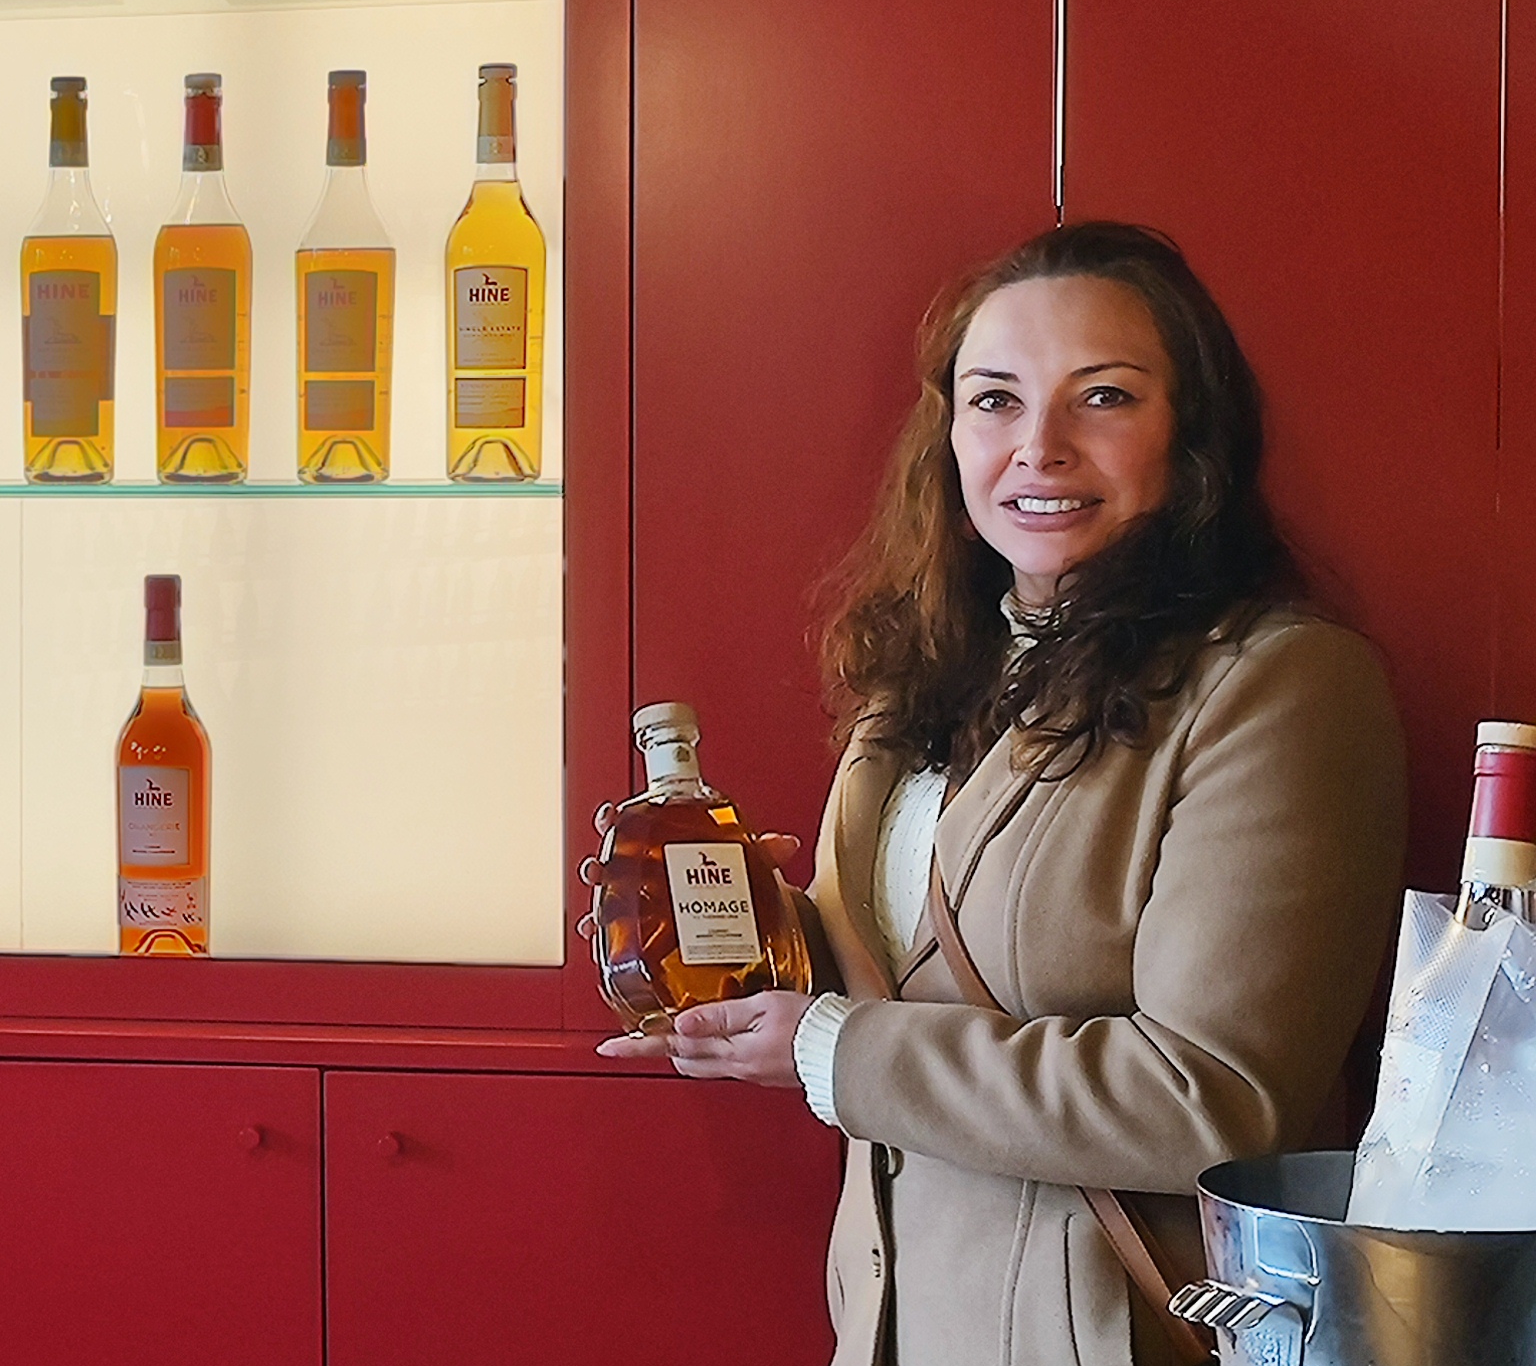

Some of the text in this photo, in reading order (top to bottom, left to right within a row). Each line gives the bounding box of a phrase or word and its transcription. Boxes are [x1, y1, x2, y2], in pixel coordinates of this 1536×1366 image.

[35, 284, 90, 300] HINE
[179, 289, 218, 304] HINE
[319, 291, 357, 307] HINE
[469, 288, 511, 303] HINE
[134, 792, 173, 807] HINE
[686, 868, 733, 885] HINE
[679, 900, 750, 914] HOMAGE
